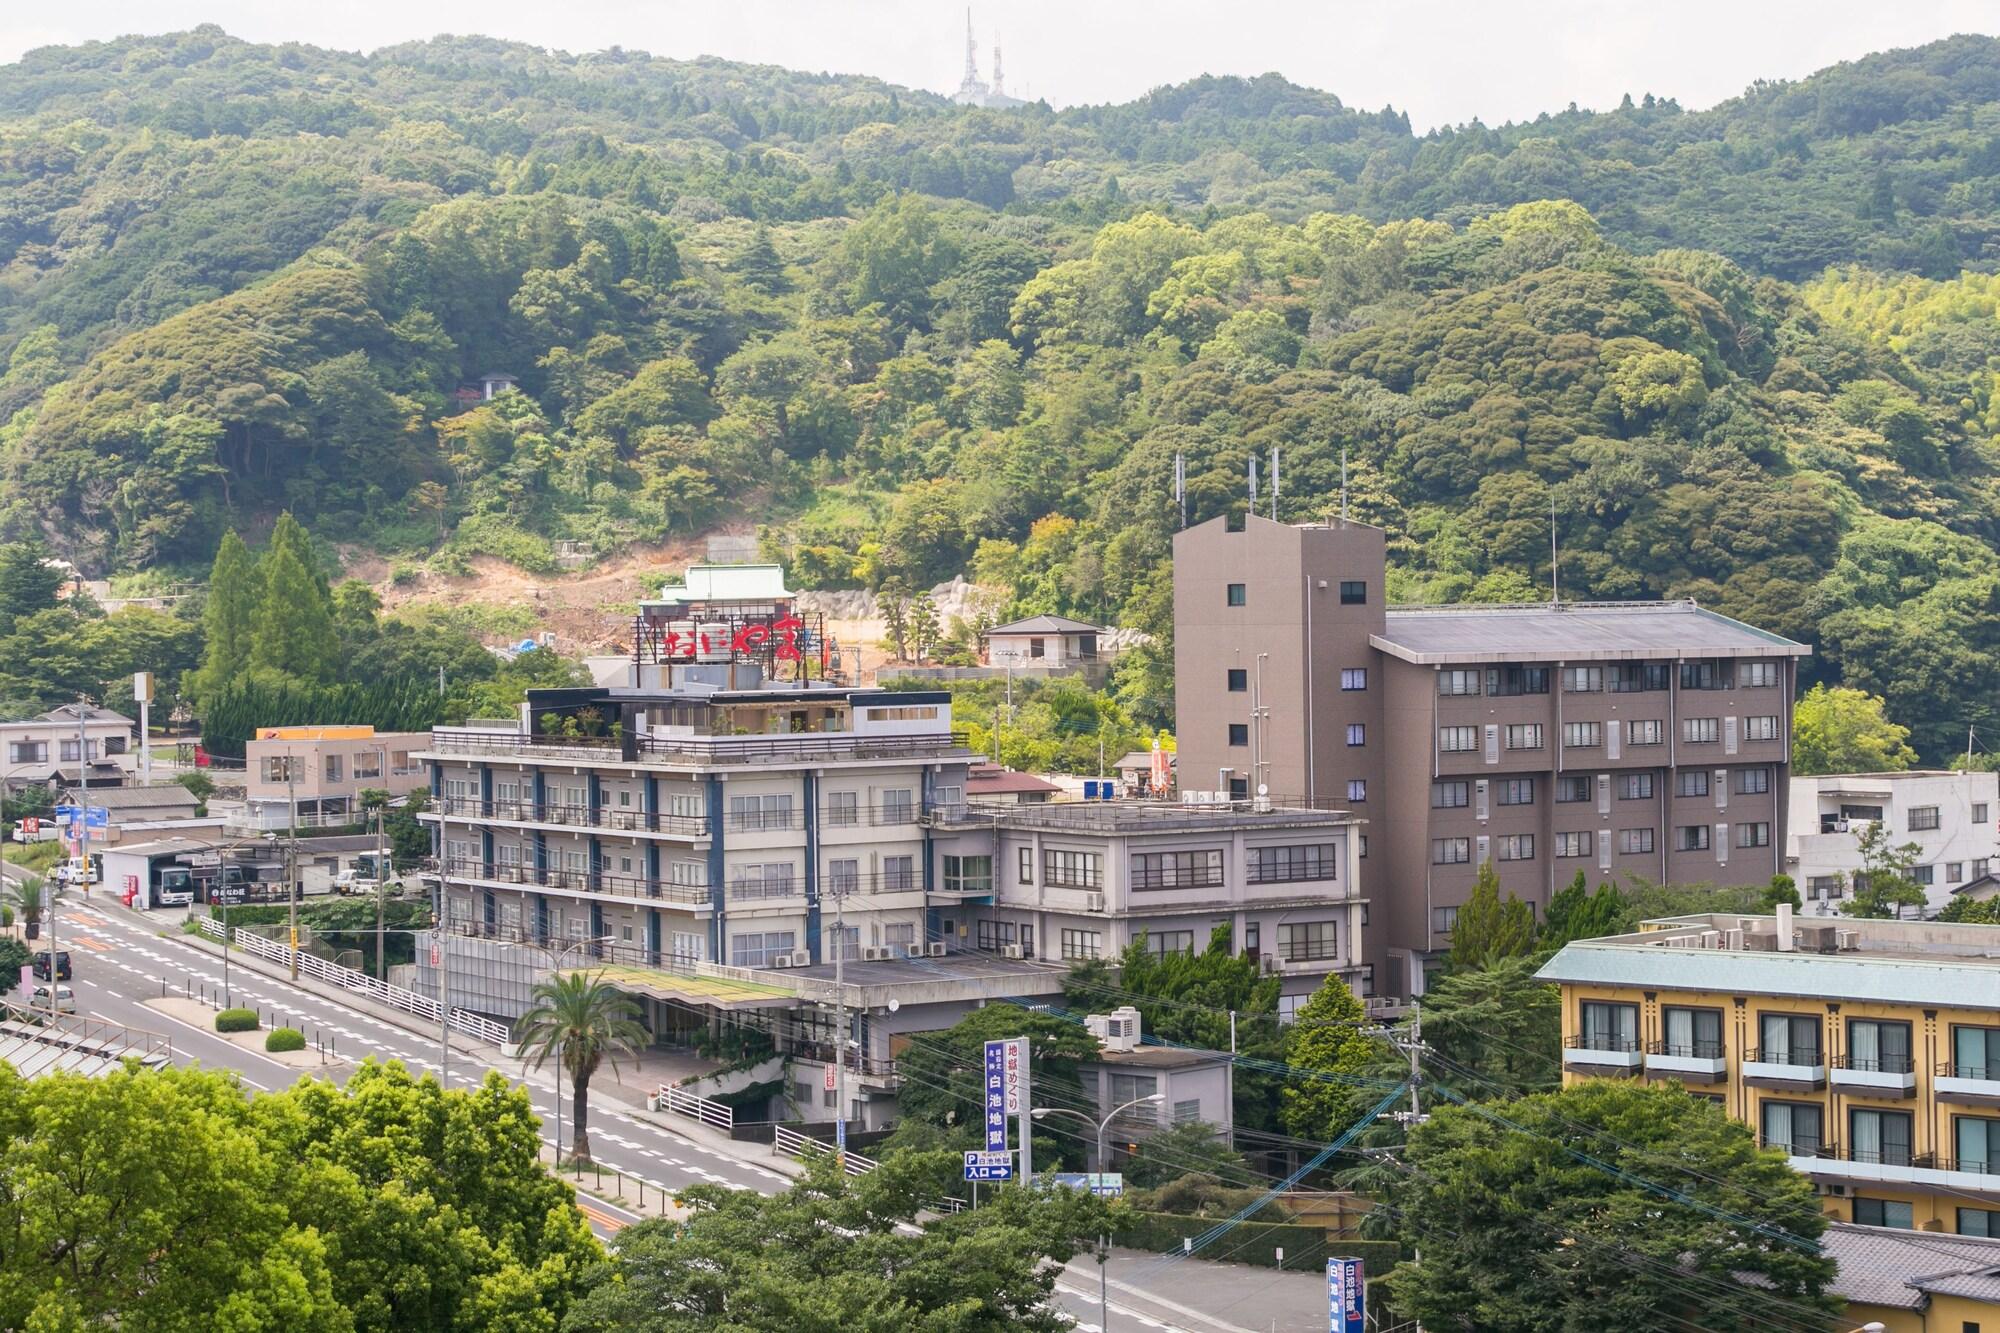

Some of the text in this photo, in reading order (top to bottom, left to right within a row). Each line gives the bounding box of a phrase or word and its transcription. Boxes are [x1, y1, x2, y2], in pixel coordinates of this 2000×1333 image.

[1008, 1044, 1018, 1110] 地獄めぐり
[989, 1075, 1003, 1145] 白池地獄
[968, 1154, 976, 1165] P
[979, 1157, 1010, 1165] 白池地獄
[968, 1167, 990, 1178] 入口
